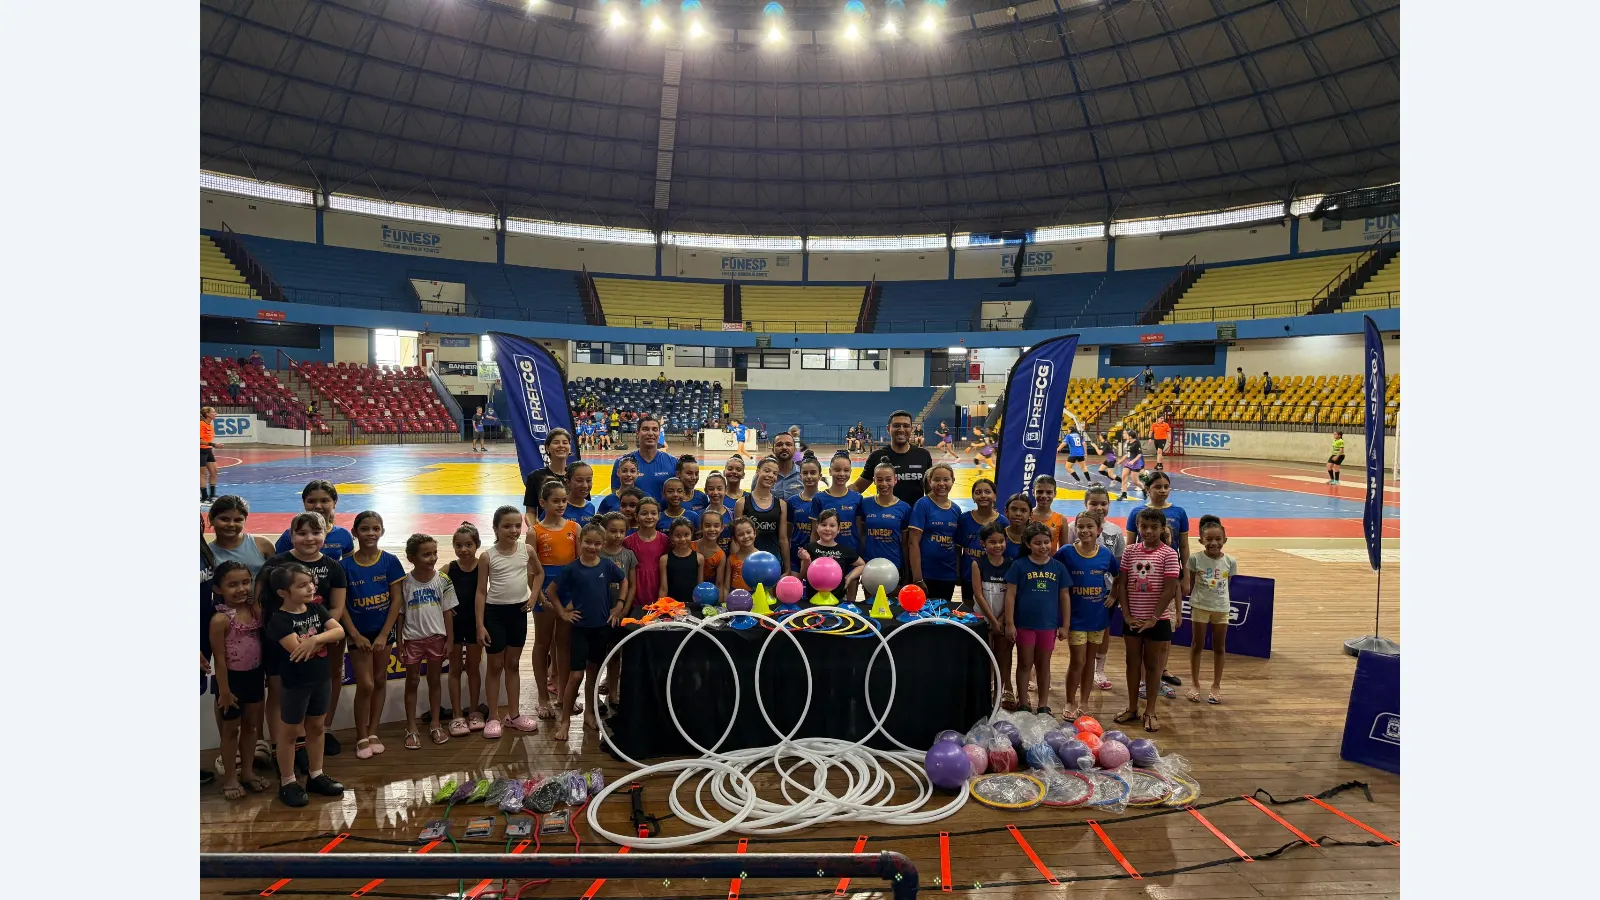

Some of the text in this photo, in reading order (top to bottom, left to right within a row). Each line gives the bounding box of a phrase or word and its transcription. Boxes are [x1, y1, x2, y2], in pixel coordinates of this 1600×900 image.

[1364, 213, 1400, 232] FUN
[382, 229, 441, 246] FUNESP
[721, 256, 767, 271] FUNESP
[1001, 252, 1053, 267] FESP
[520, 360, 544, 421] PREFCG
[1028, 364, 1050, 428] PREFCG
[213, 418, 250, 435] ESP
[1022, 453, 1037, 497] NESP
[840, 521, 853, 530] ESP
[1027, 571, 1057, 581] BRASIL
